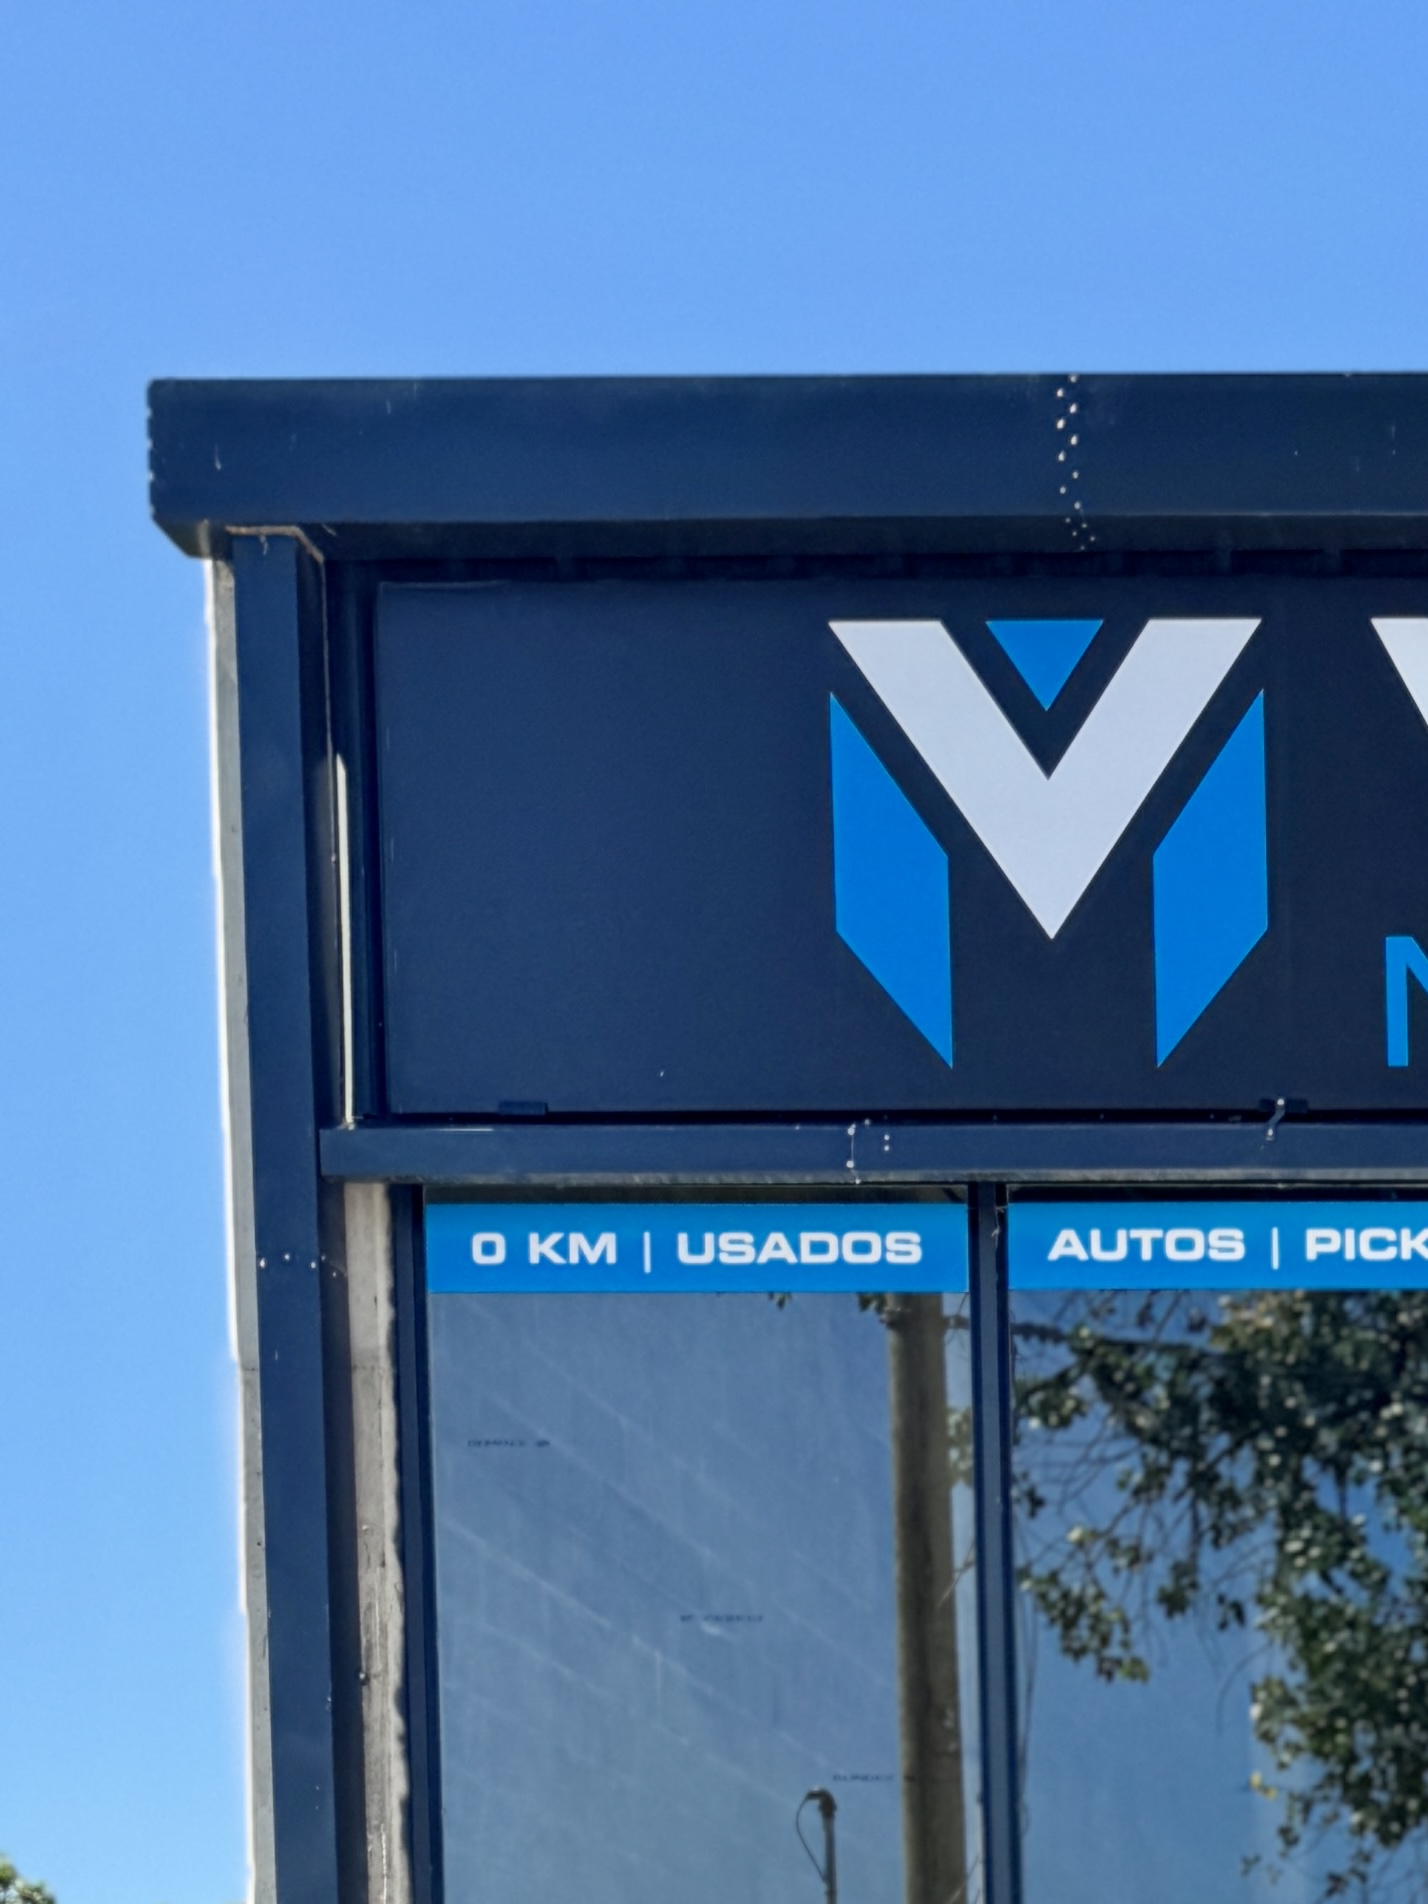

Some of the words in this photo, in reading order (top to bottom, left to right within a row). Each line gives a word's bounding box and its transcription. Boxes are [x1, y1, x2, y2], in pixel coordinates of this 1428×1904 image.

[528, 1232, 617, 1265] KM
[677, 1231, 923, 1265] USADOS
[1047, 1227, 1246, 1262] AUTOS
